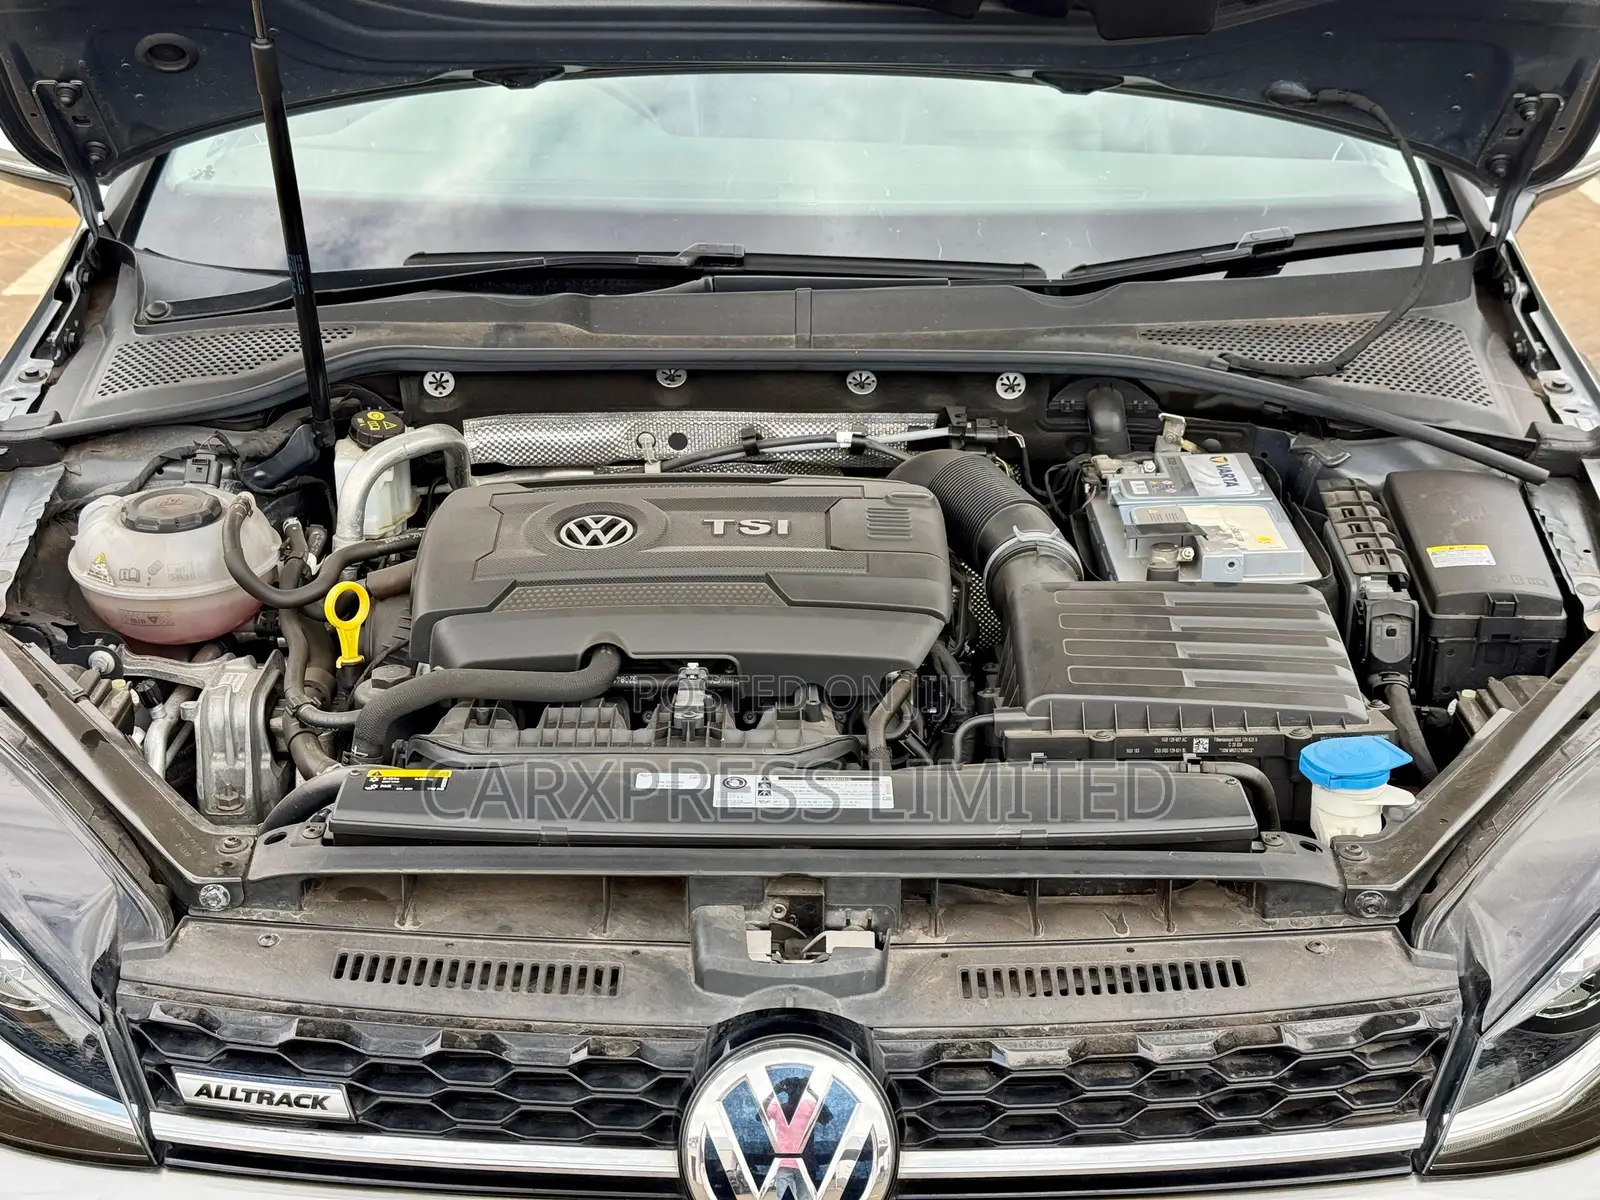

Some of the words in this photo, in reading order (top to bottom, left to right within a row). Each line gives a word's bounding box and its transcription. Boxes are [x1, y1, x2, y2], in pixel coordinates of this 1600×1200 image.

[1215, 464, 1240, 488] VARTA
[703, 518, 792, 536] TSI
[130, 616, 146, 624] min
[194, 1083, 331, 1110] ALLTRACK
